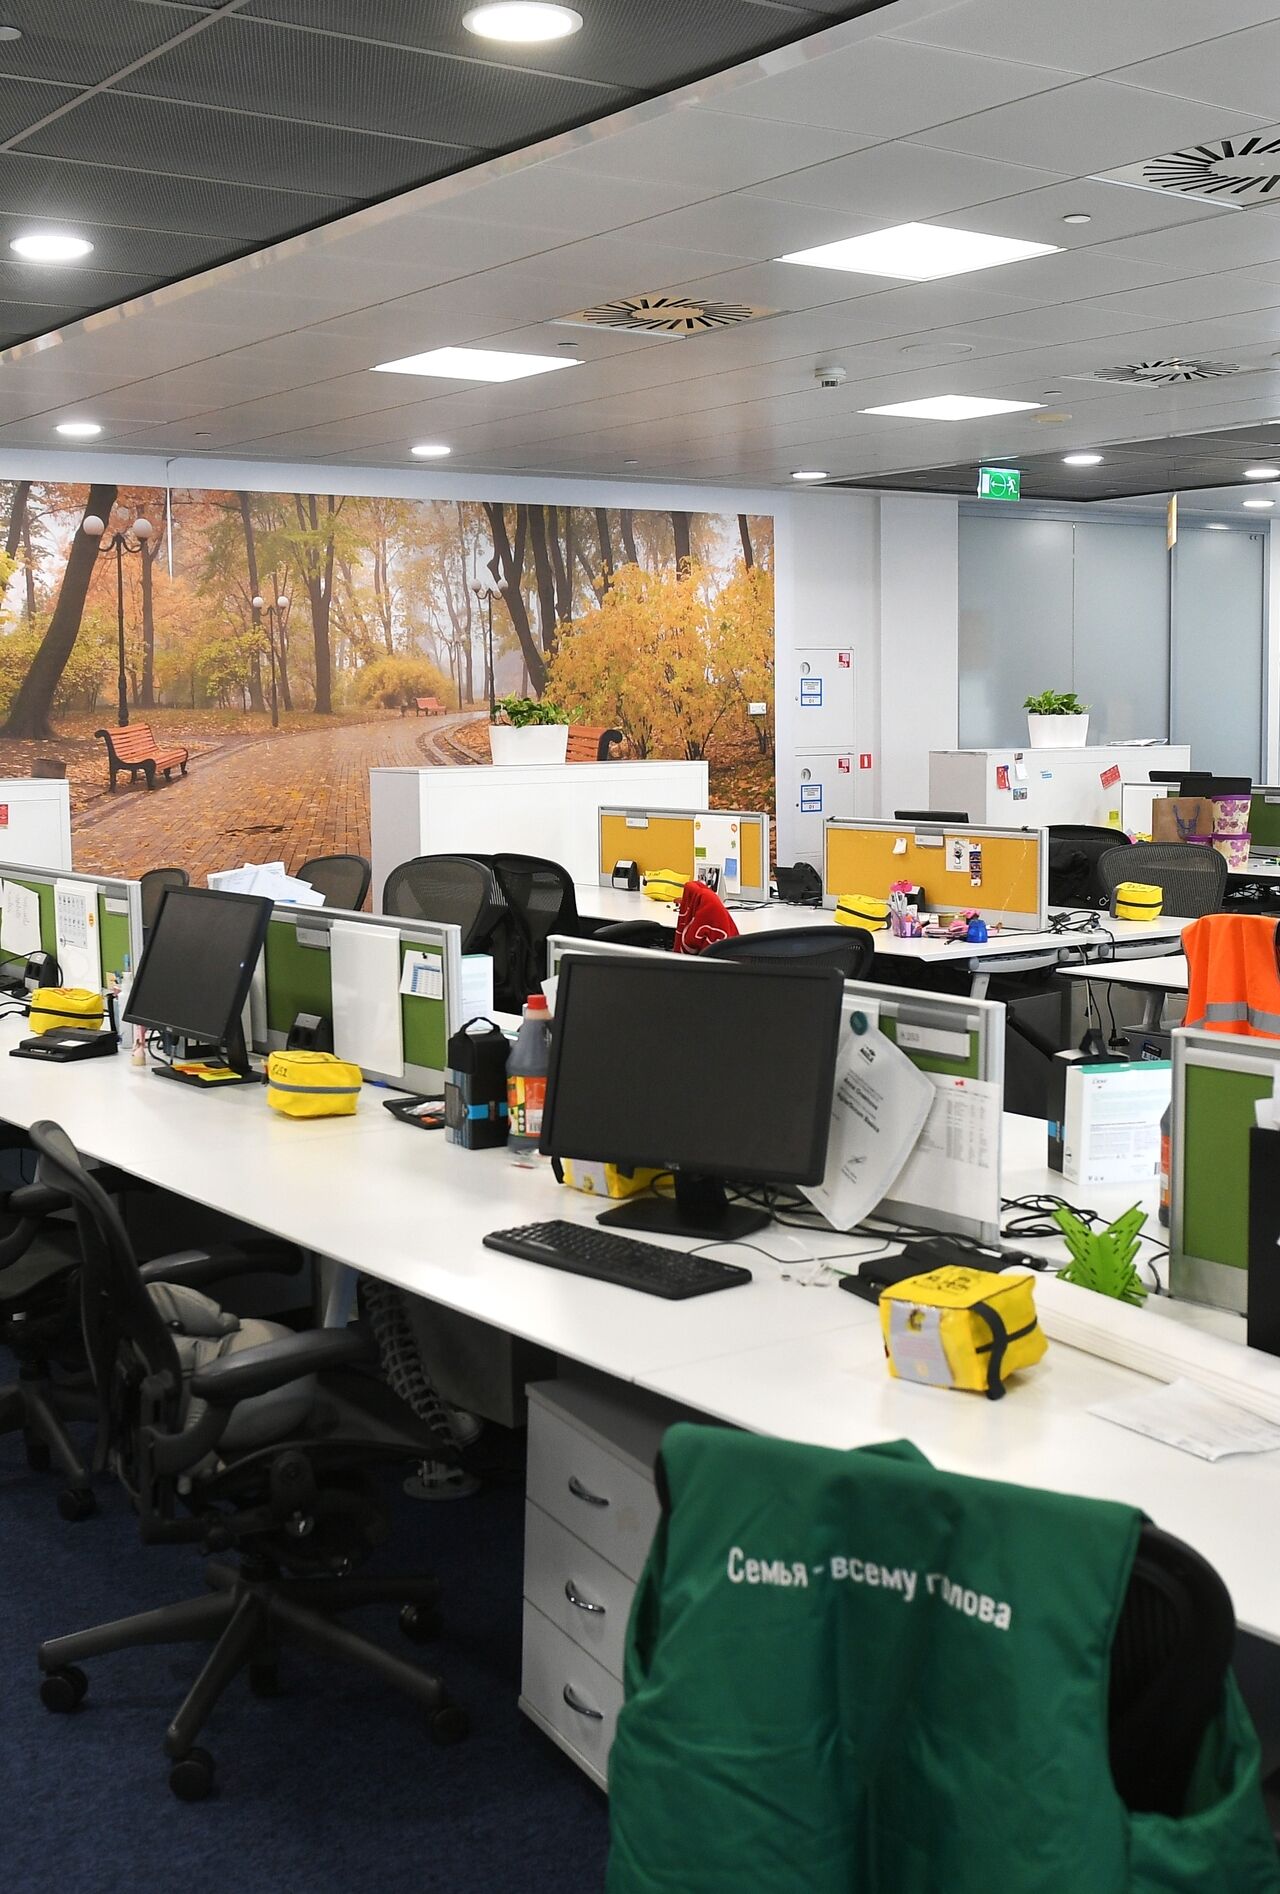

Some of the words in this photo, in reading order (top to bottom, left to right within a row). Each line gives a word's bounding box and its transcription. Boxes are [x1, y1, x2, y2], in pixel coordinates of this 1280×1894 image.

[727, 1546, 809, 1588] Семья
[812, 1565, 824, 1576] -
[830, 1555, 918, 1602] всему
[926, 1573, 1012, 1631] глова
